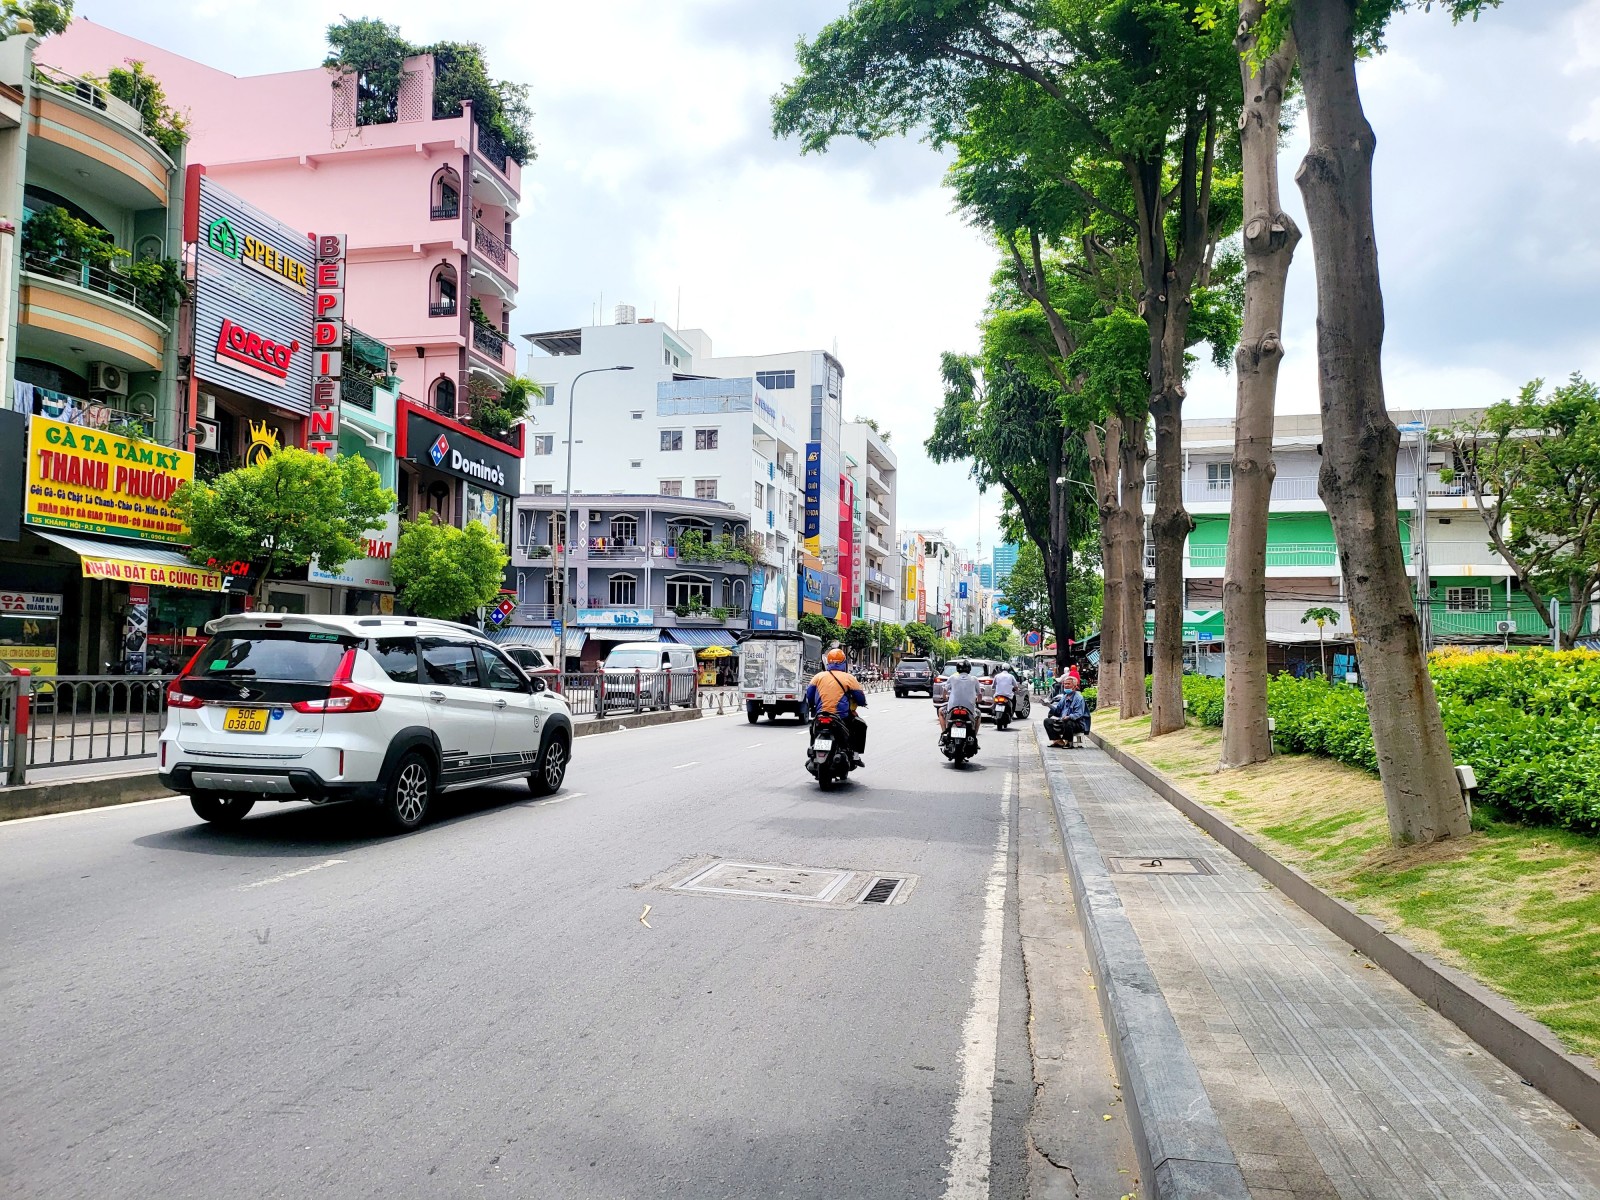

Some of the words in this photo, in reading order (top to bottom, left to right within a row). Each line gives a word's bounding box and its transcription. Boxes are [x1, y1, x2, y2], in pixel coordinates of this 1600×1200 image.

[244, 235, 307, 287] SPELIER
[46, 426, 77, 449] GÀ
[81, 434, 108, 455] TA
[114, 442, 153, 466] TAM
[38, 449, 109, 490] THANH
[452, 449, 504, 486] Domino's
[31, 516, 42, 524] 125
[44, 517, 68, 527] KHÁNH
[123, 564, 146, 582] ĐẶT
[150, 566, 165, 583] GÀ
[168, 569, 198, 586] CÚNG
[201, 570, 219, 588] TẾT
[1, 594, 26, 603] GÀ
[32, 595, 44, 603] TAM
[238, 709, 257, 720] 50E
[228, 719, 261, 731] 038.00
